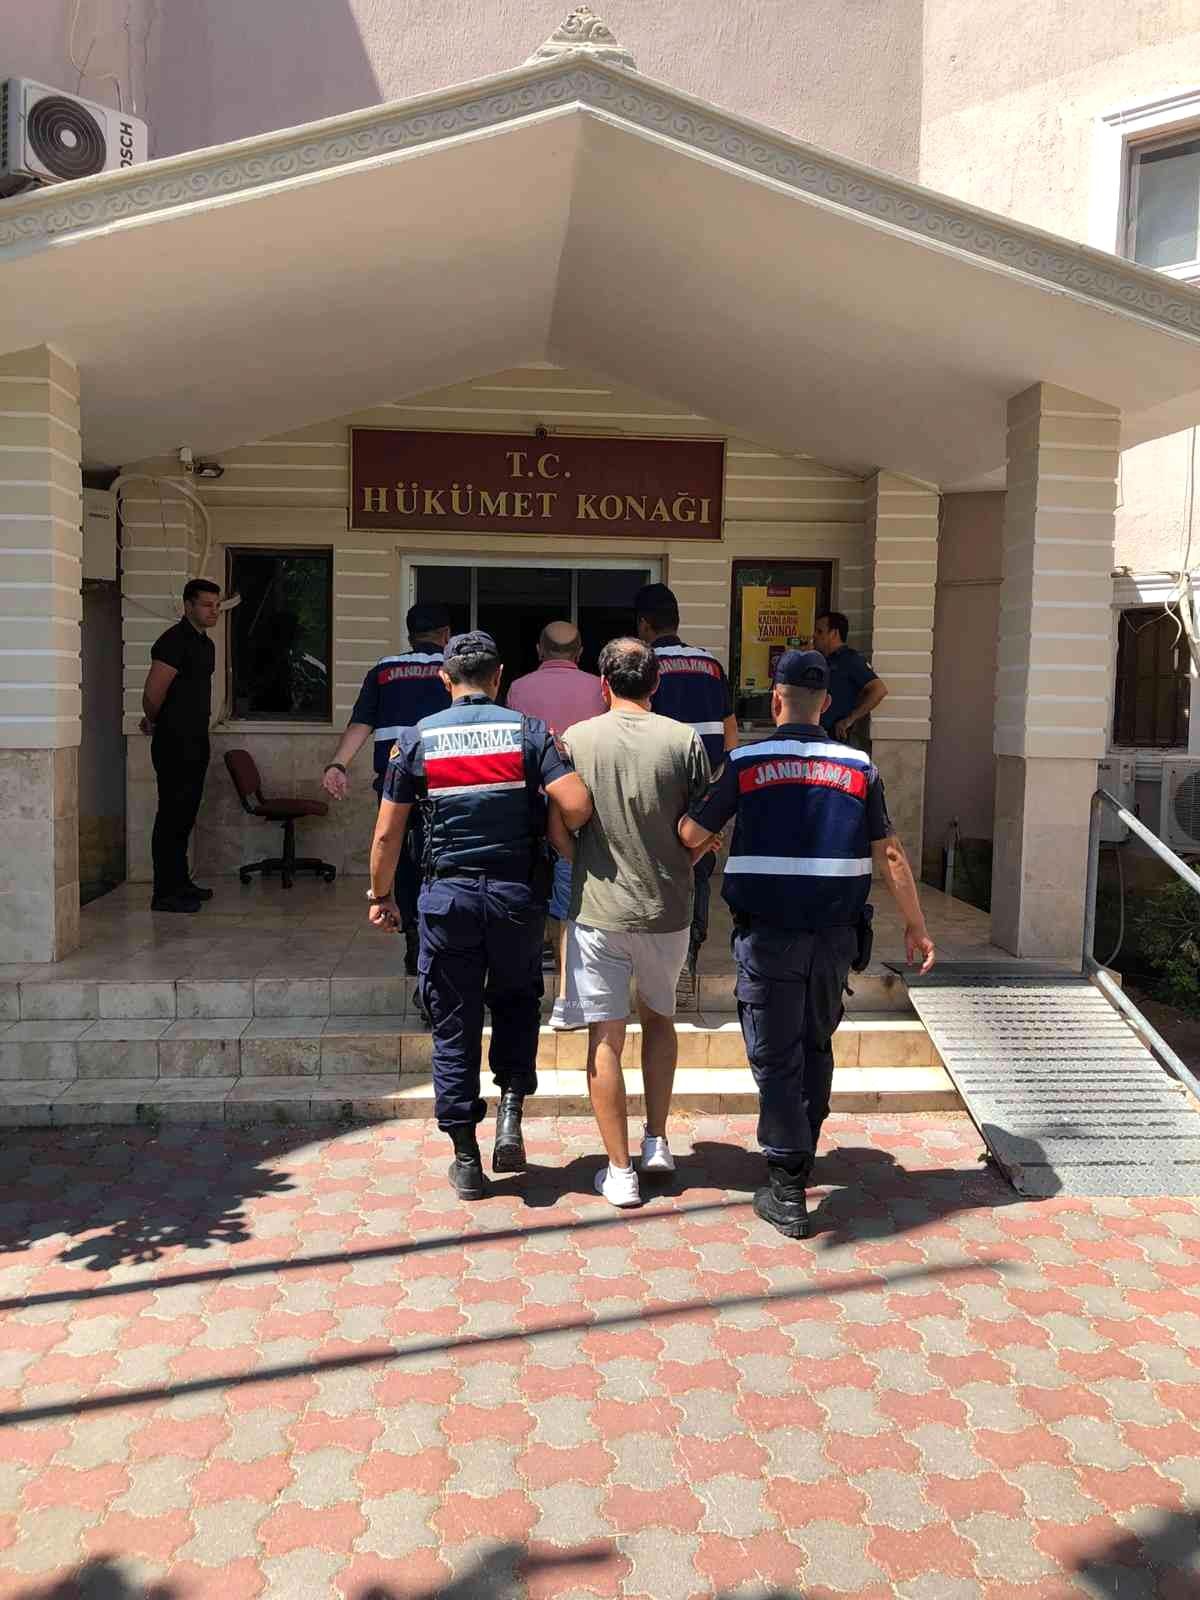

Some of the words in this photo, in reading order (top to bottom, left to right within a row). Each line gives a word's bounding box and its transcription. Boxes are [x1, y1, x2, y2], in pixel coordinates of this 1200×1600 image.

[506, 451, 572, 479] T.C.
[363, 482, 557, 519] HÜKÜMET
[575, 491, 713, 524] KONAĞI
[434, 728, 514, 751] JANDARMA
[754, 760, 854, 787] JANDARMA
